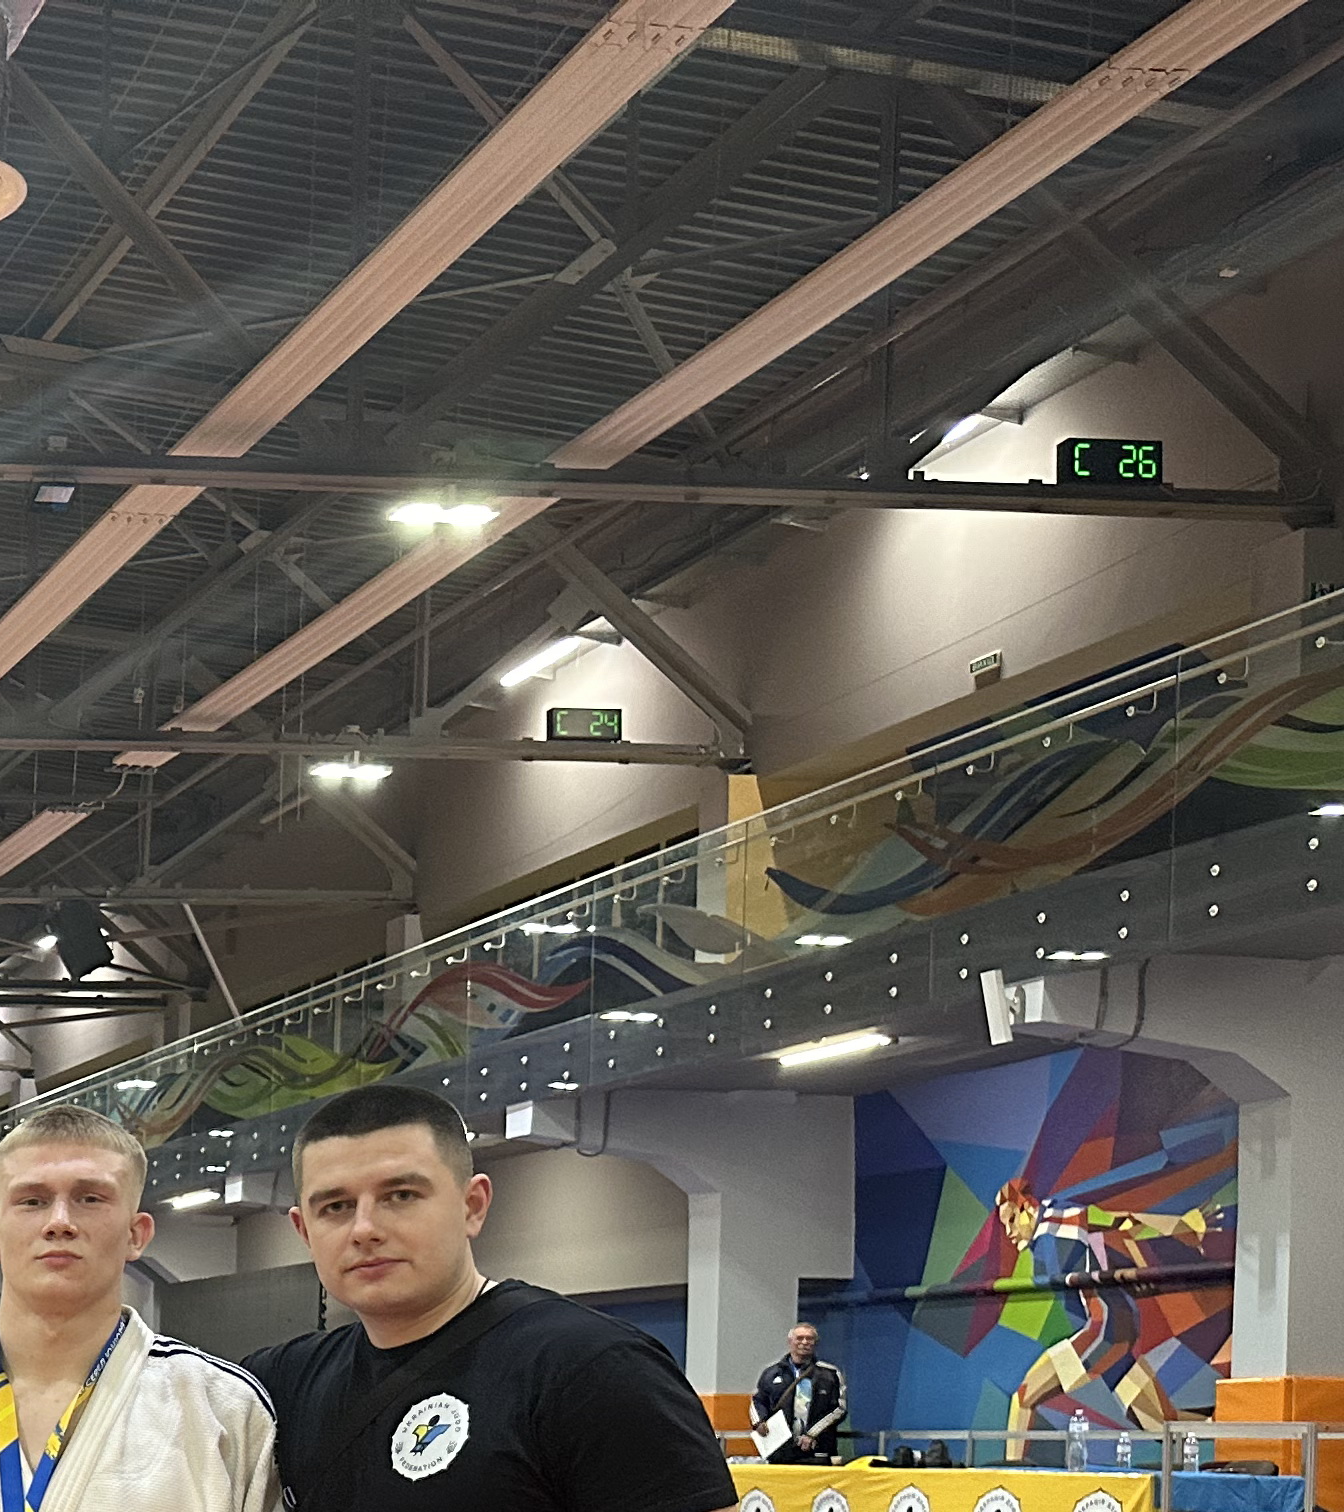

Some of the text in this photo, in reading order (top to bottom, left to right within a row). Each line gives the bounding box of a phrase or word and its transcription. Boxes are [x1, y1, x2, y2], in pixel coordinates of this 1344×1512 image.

[1119, 445, 1155, 478] 26
[590, 711, 618, 735] 24
[401, 1402, 451, 1434] UKRAINIAN
[399, 1456, 443, 1472] FEDERATION
